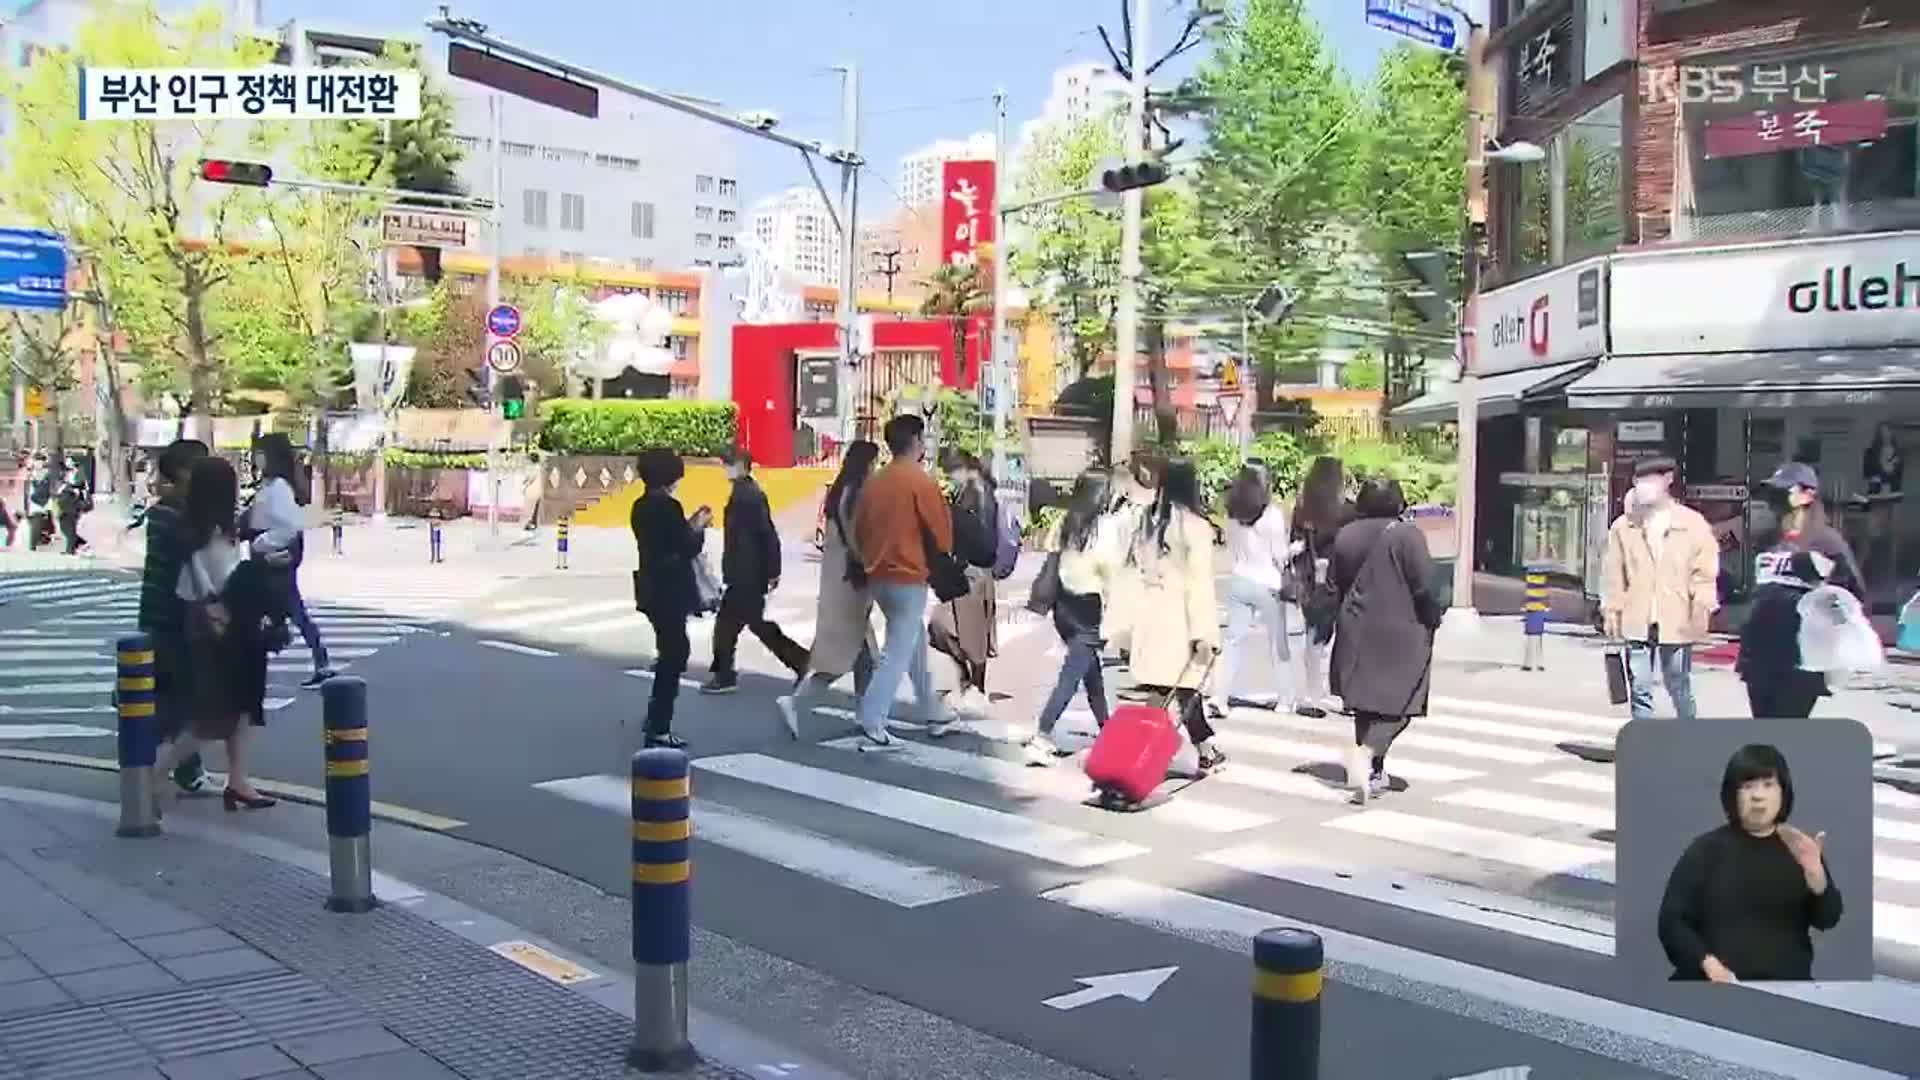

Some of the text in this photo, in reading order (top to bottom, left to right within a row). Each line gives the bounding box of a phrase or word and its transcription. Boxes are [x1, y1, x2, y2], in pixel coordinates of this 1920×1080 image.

[1757, 110, 1829, 145] 본죽
[1788, 262, 1920, 313] olleh
[1492, 306, 1525, 347] olleh
